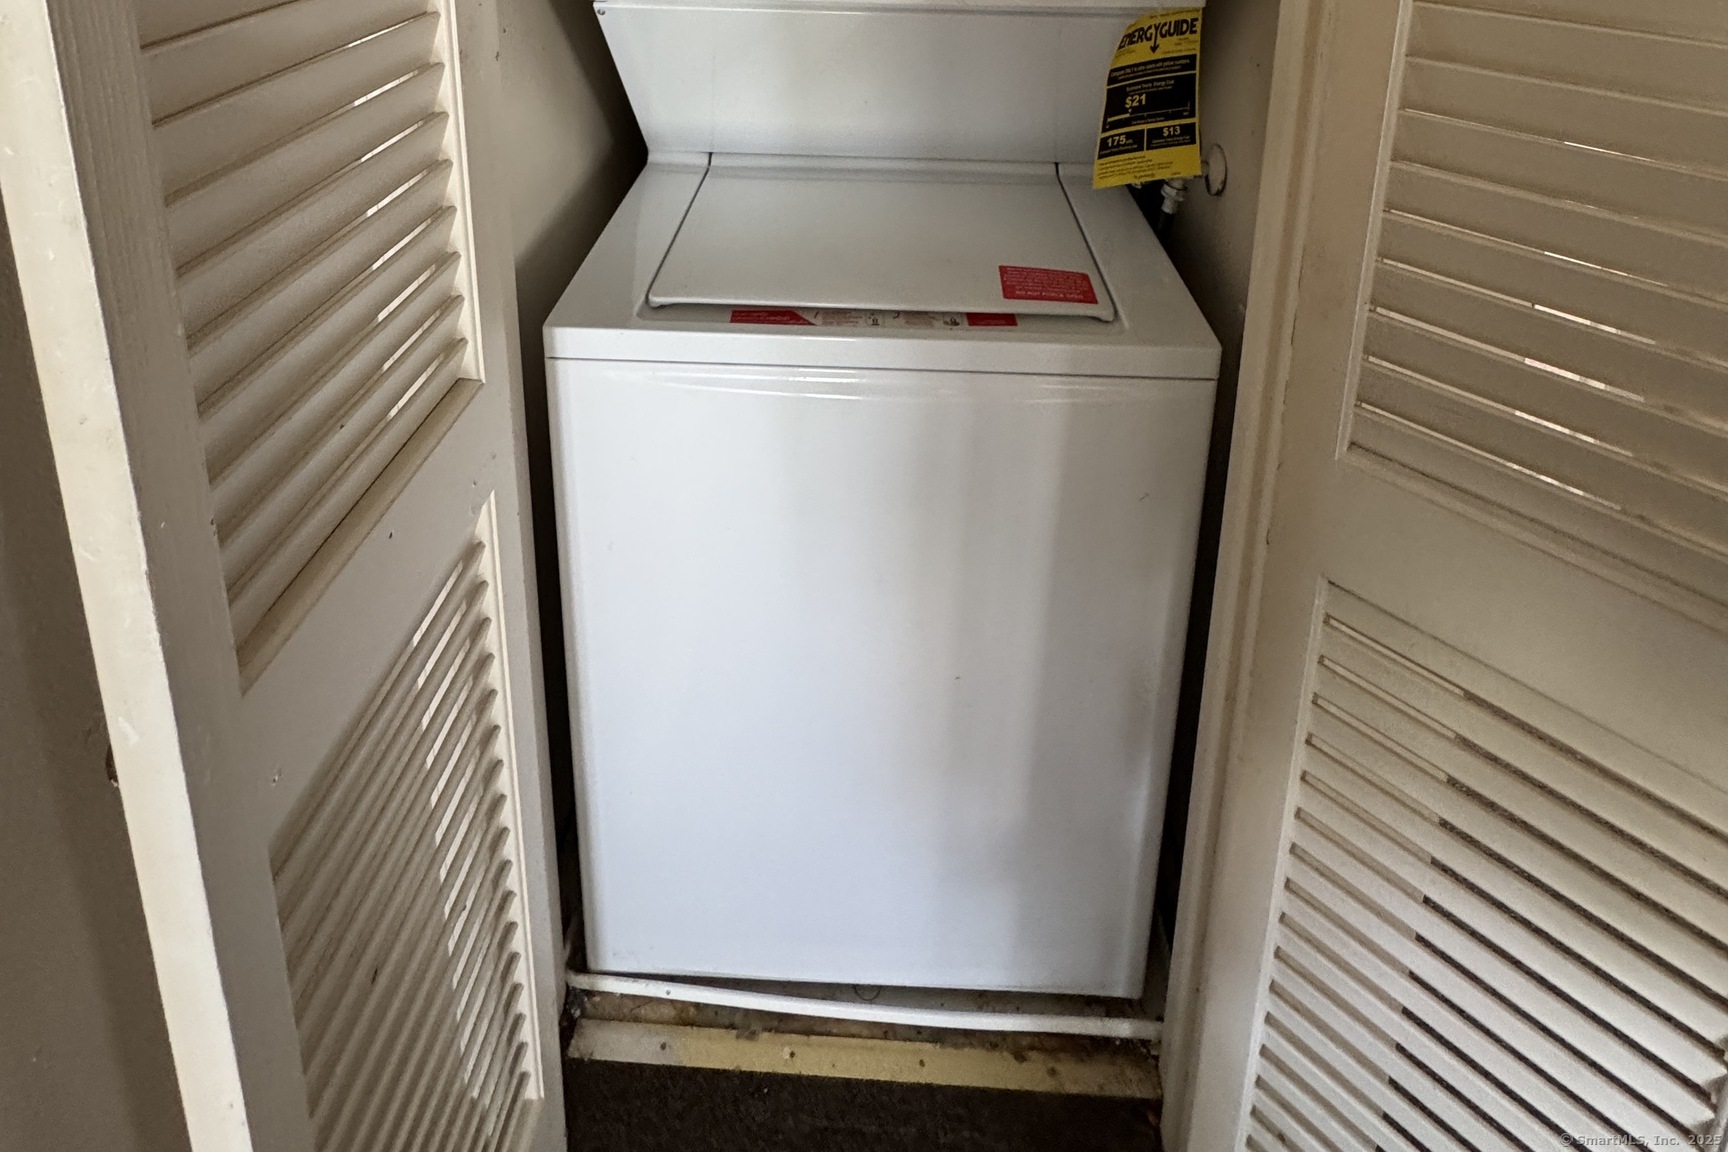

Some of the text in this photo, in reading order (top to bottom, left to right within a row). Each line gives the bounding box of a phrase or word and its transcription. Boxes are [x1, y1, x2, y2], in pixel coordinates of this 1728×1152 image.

[1117, 17, 1199, 52] ENERGYGUIDE
[1125, 93, 1147, 108] $21
[1162, 126, 1181, 136] $13
[1106, 135, 1126, 147] 175
